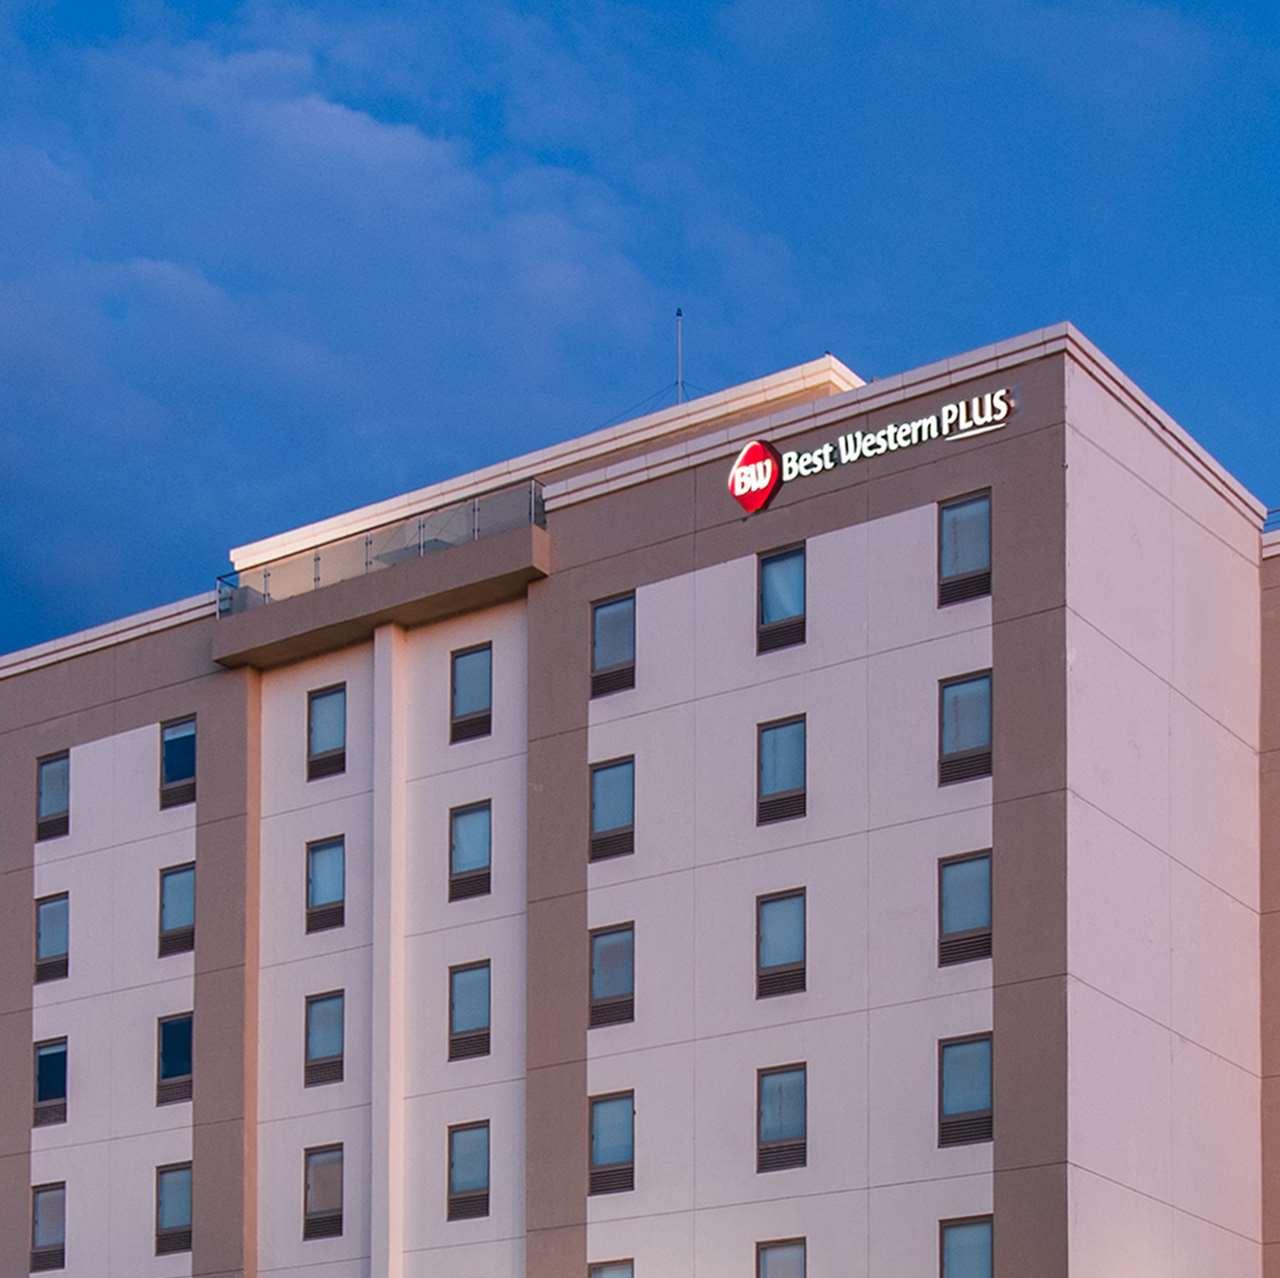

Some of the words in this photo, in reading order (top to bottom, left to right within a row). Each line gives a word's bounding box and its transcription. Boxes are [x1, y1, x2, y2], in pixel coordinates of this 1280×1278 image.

[733, 458, 771, 497] BW
[782, 442, 835, 482] Best
[838, 413, 939, 464] Western
[941, 388, 1011, 437] PLUS
